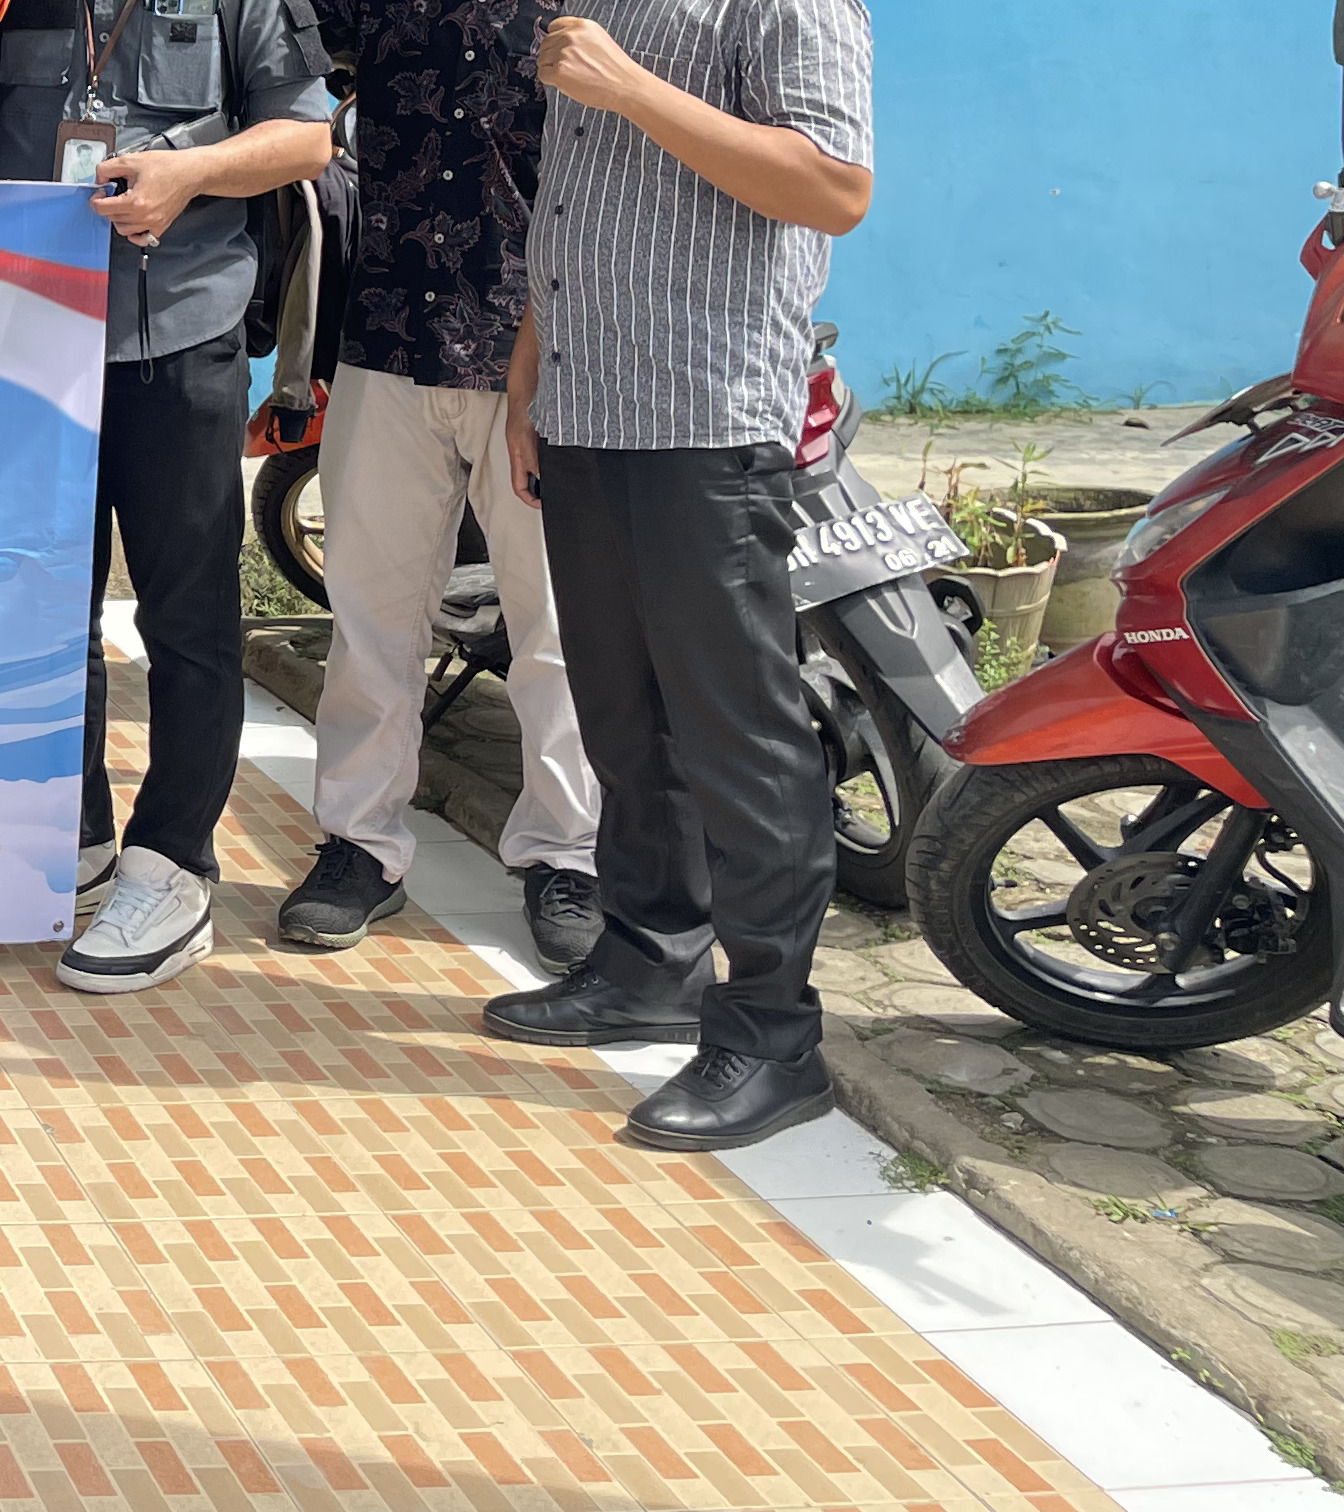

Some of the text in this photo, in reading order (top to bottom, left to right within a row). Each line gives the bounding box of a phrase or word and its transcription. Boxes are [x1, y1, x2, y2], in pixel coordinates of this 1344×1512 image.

[819, 511, 893, 556] 4913
[888, 499, 939, 535] VE
[1123, 627, 1190, 645] HONDA
